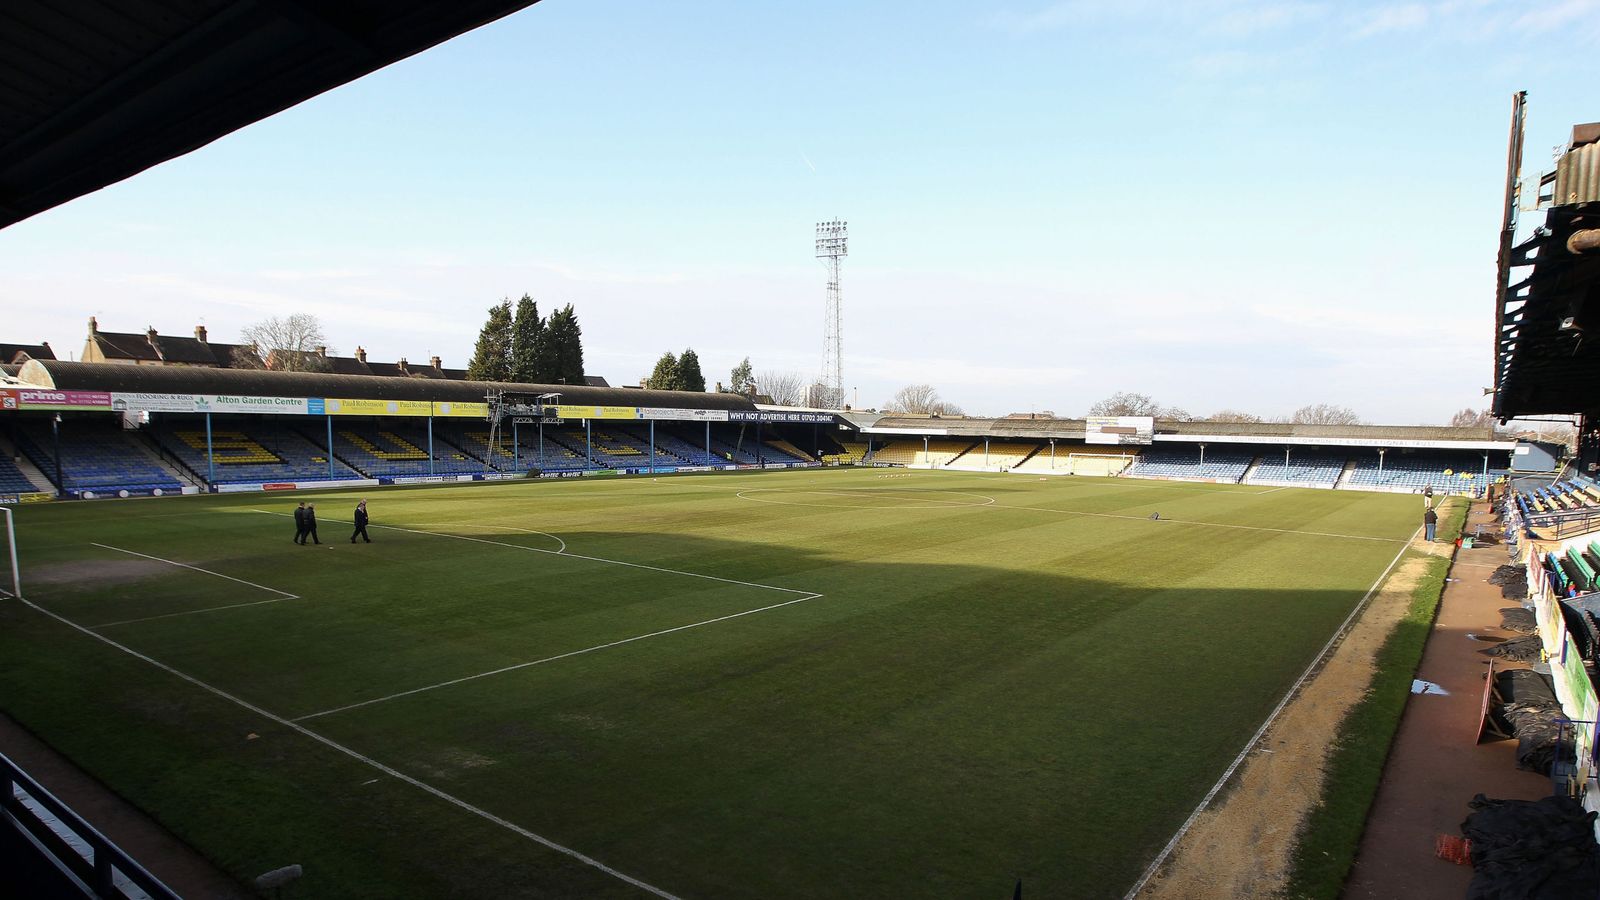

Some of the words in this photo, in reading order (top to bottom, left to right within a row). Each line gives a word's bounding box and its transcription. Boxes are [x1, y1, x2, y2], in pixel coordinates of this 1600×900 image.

[20, 390, 66, 401] prime
[216, 396, 239, 404] Alton
[242, 396, 272, 405] Garden
[274, 397, 303, 406] Centre
[730, 412, 744, 420] WHY
[746, 412, 758, 420] NOT
[760, 413, 786, 421] ADVERTISE
